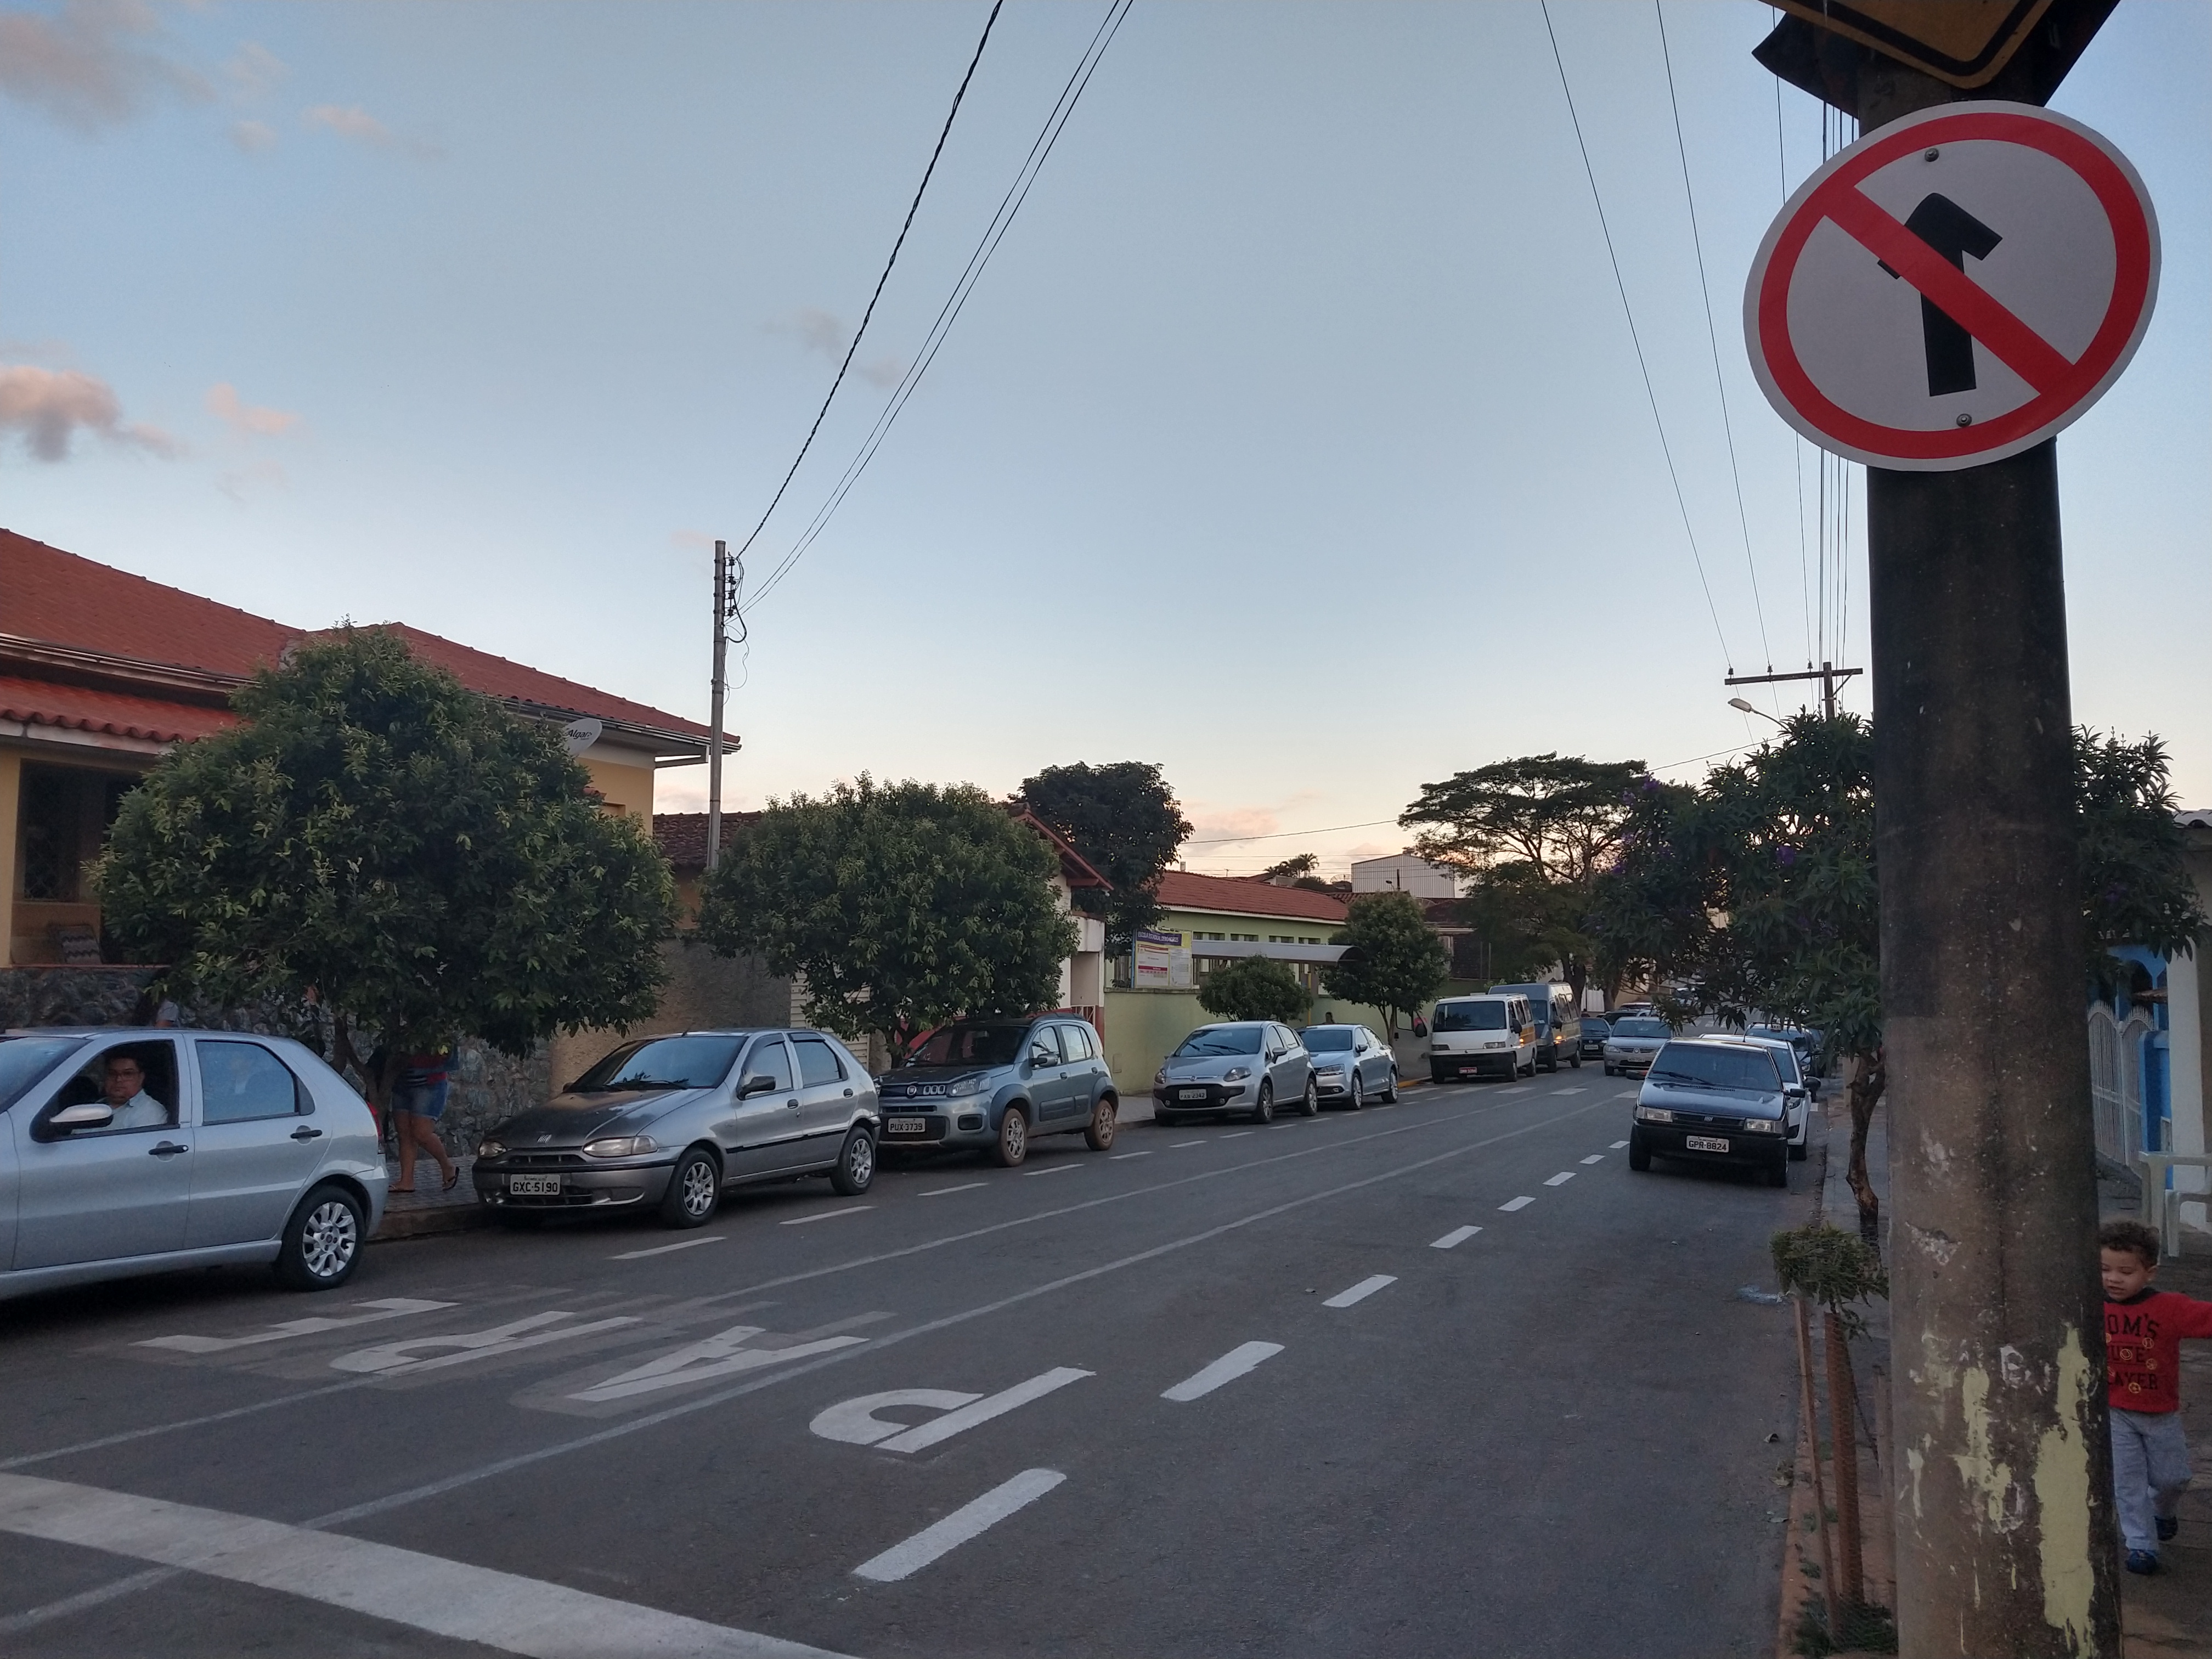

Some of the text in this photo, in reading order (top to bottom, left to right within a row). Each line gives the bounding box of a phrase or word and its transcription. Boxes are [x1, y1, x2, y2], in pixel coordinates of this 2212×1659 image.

[568, 729, 589, 740] Algar
[1148, 933, 1161, 941] ESTADUAL
[2108, 1313, 2160, 1339] OM'S
